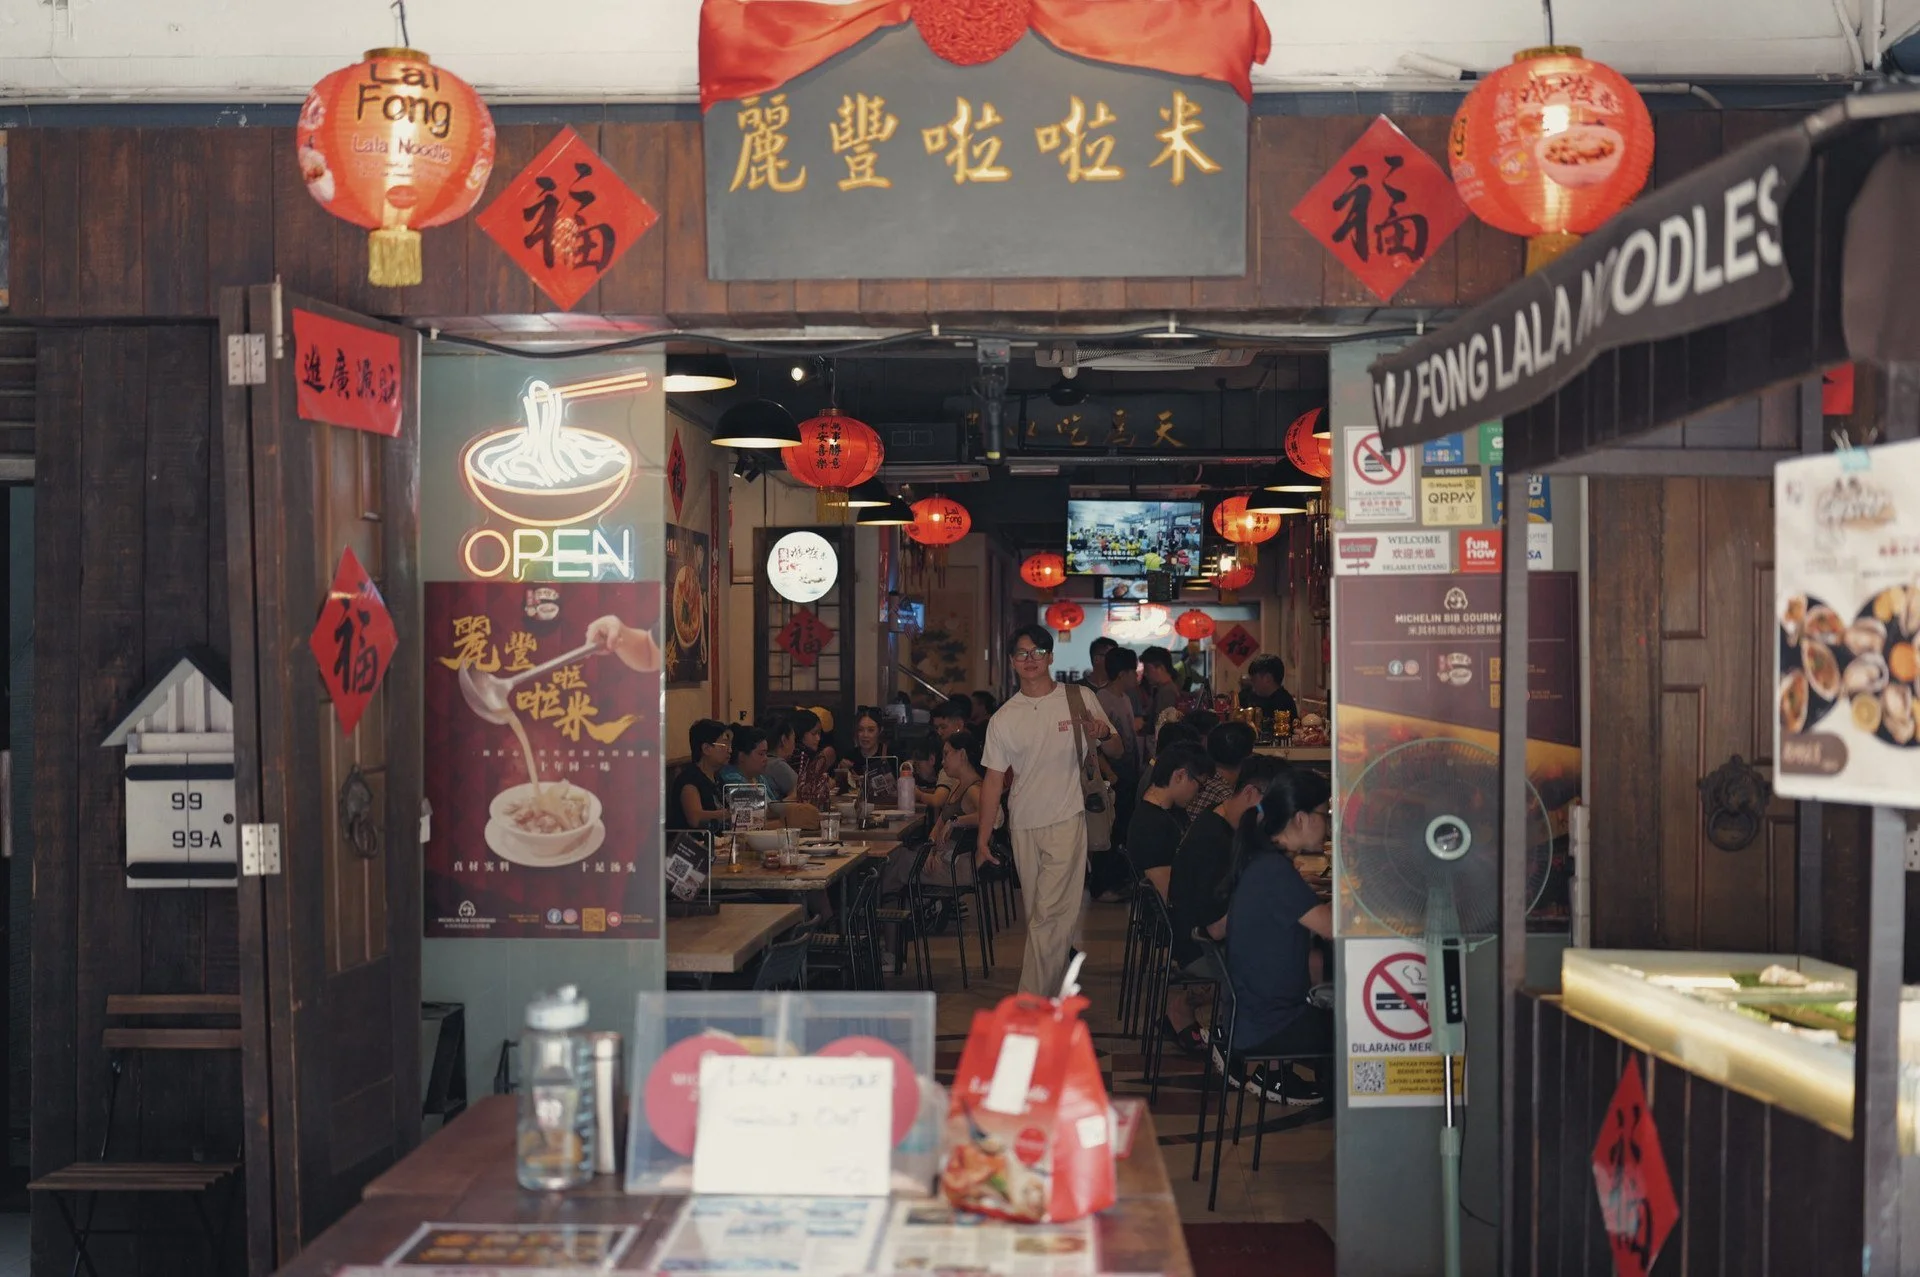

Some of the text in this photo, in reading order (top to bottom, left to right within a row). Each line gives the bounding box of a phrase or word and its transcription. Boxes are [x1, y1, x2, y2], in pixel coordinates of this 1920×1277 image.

[370, 63, 440, 92] Lai
[357, 84, 453, 139] Fong
[353, 136, 452, 165] Lala Noodle
[728, 90, 1222, 192] 麗豐啦啦米
[522, 162, 617, 274] 福
[1331, 156, 1430, 264] 福
[1413, 333, 1489, 424] FONG
[1492, 285, 1572, 392] LALA
[1575, 165, 1784, 346] NODLES
[1428, 491, 1475, 504] QRPAY
[464, 529, 630, 579] OPEN
[1388, 535, 1441, 544] WELCOME
[1467, 549, 1497, 559] now
[1395, 614, 1441, 623] MICHELIN
[1443, 614, 1460, 622] BIB
[333, 581, 379, 695] 福
[172, 792, 202, 810] 99
[172, 830, 222, 848] 99-A
[1352, 1043, 1406, 1053] DILARANG
